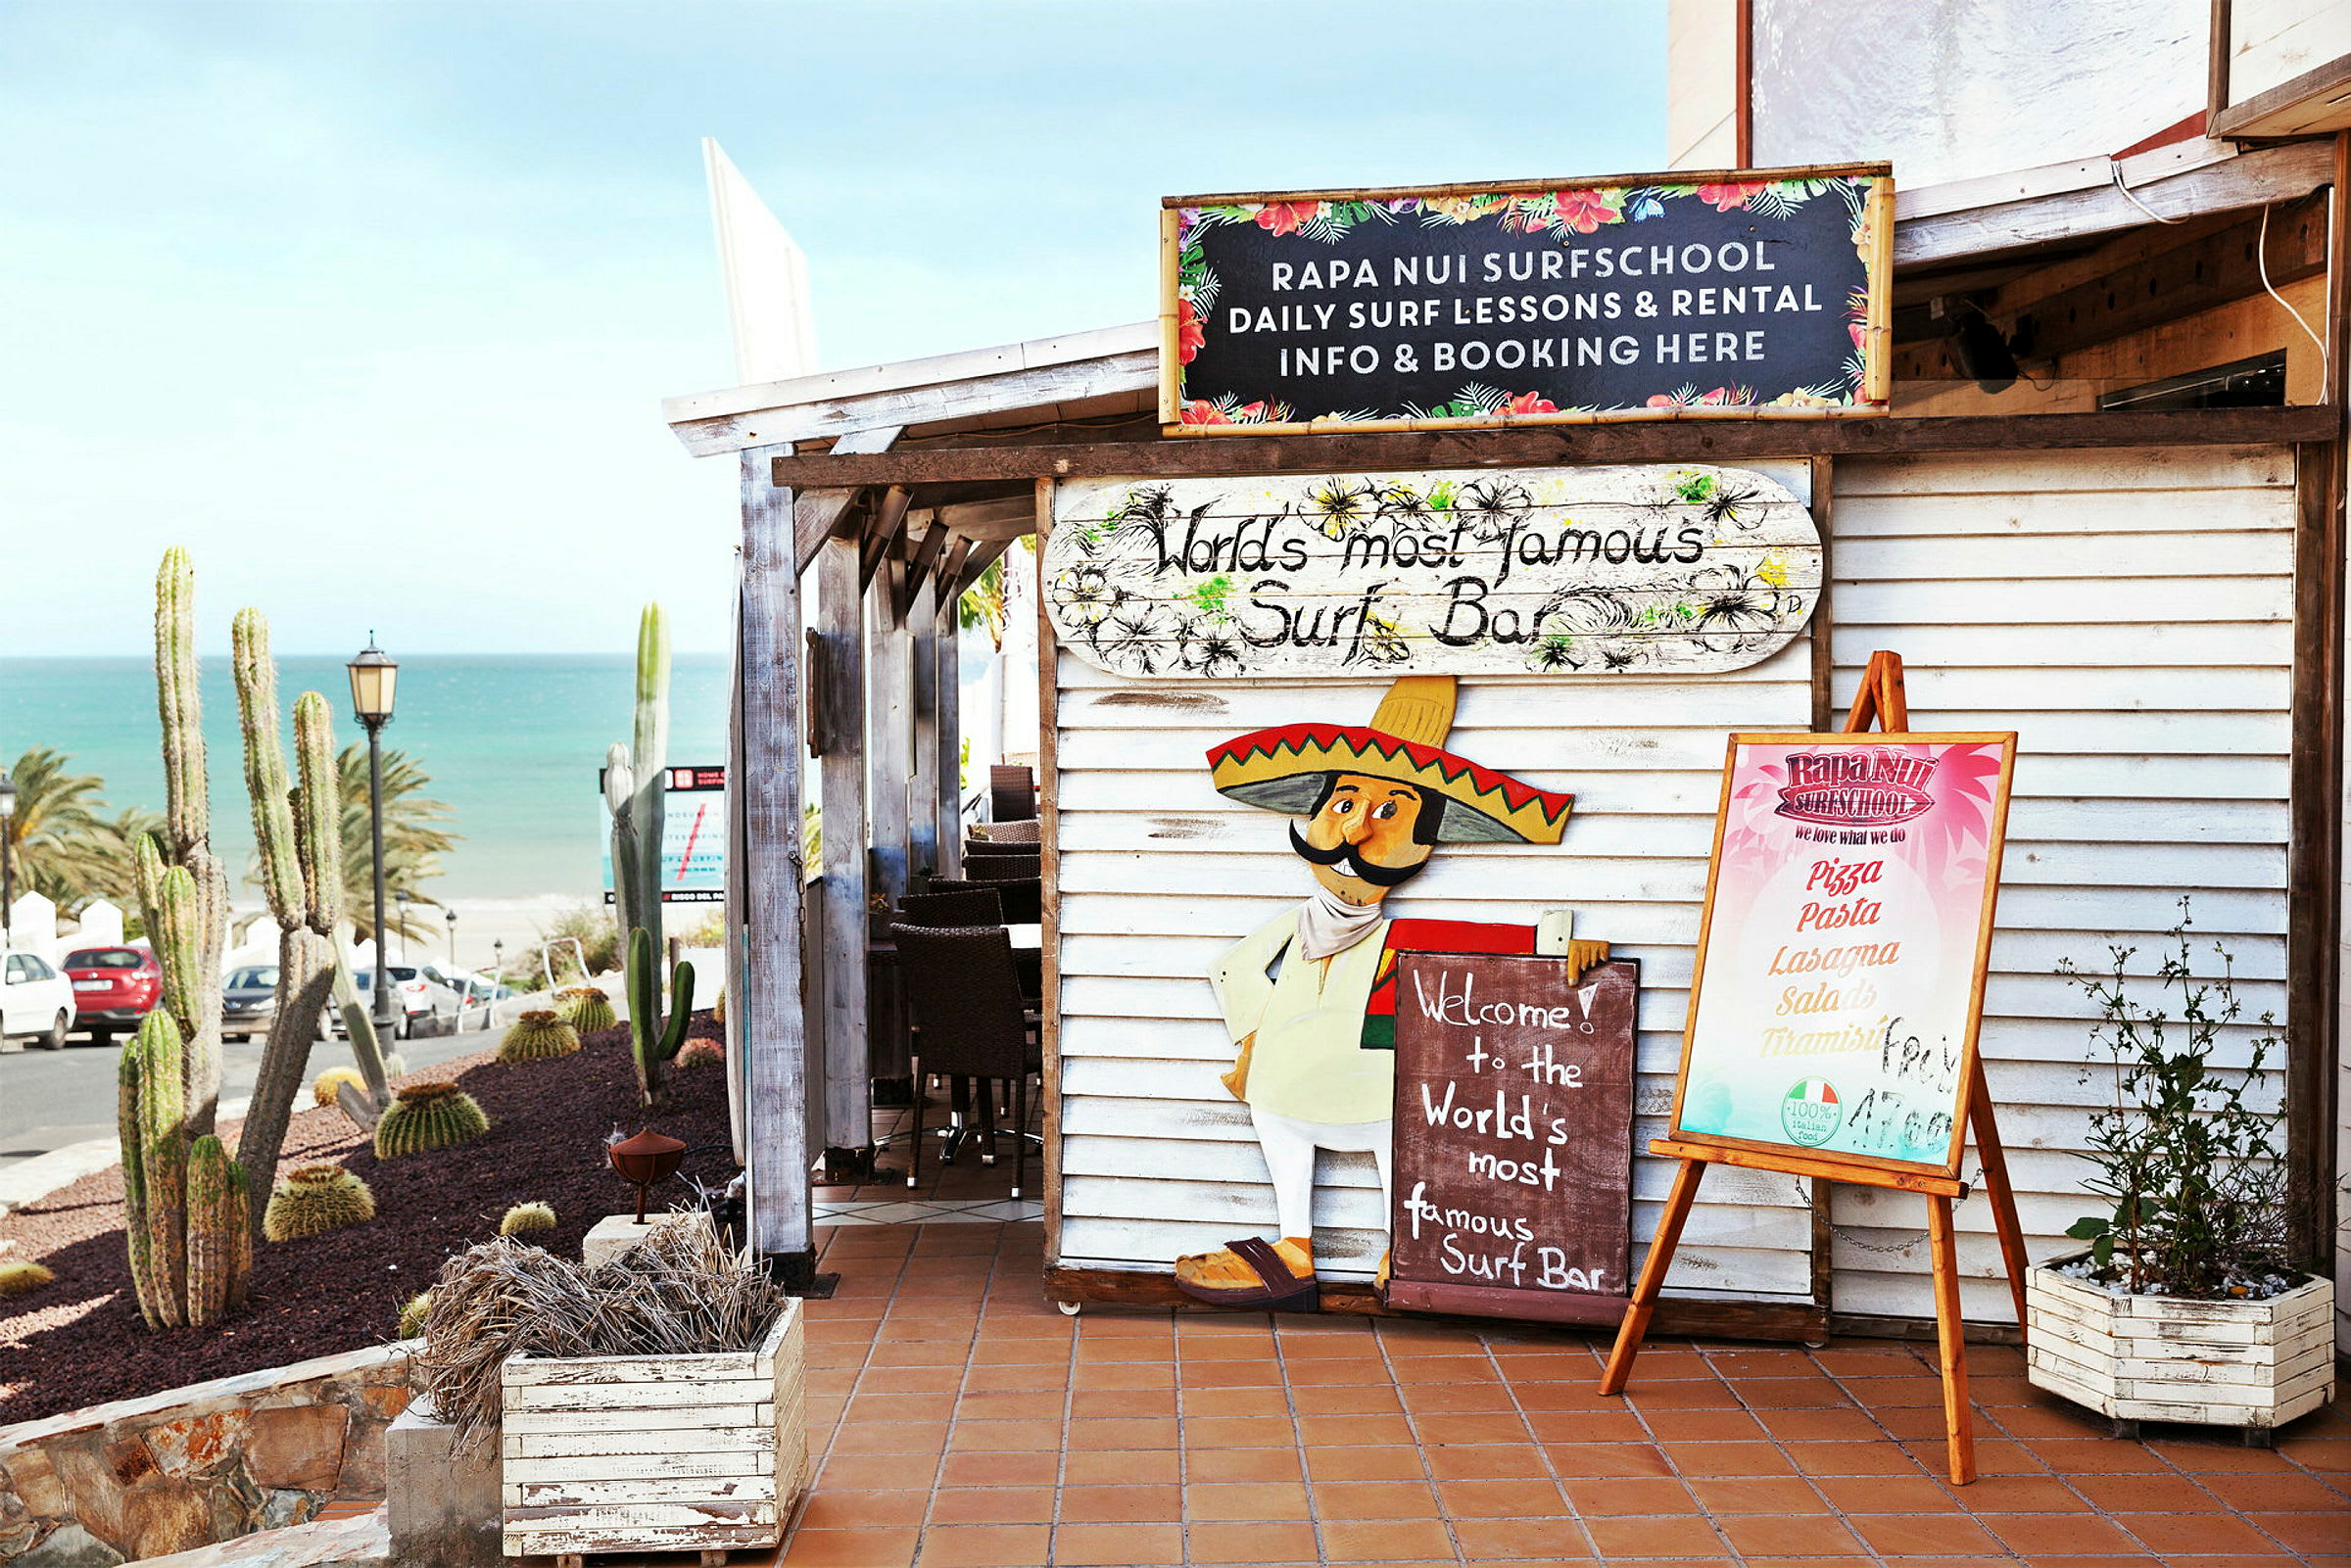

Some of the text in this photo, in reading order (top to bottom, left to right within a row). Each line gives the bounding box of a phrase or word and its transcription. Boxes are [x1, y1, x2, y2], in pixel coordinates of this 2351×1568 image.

[1272, 241, 1775, 292] RAPA NUI SURFSCHOOL
[1229, 284, 1822, 334] DAILY SURF LESSONS & RENTAL
[1280, 330, 1765, 377] INFO & BOOKING HERE
[1339, 520, 1467, 577] most
[1495, 514, 1703, 589] famous
[1240, 576, 1559, 666] Surf Bar
[1786, 746, 1940, 793] Rapa Nui
[1794, 787, 1909, 818] SURFSCHOOL
[1813, 827, 1837, 844] love
[1840, 829, 1867, 845] what
[1870, 831, 1888, 845] we
[1890, 828, 1905, 842] do
[1806, 857, 1884, 897] Pizza
[1797, 897, 1883, 932] Pasta
[1768, 941, 1901, 978] Lasagna
[1413, 969, 1599, 1034] Welcome!
[1776, 980, 1878, 1017] Salads
[1465, 1036, 1583, 1088] to the
[1421, 1080, 1567, 1145] World's
[1791, 1101, 1832, 1119] 100%
[1469, 1148, 1560, 1192] most
[1404, 1181, 1535, 1241] famous
[1440, 1233, 1605, 1291] Surf Bar
